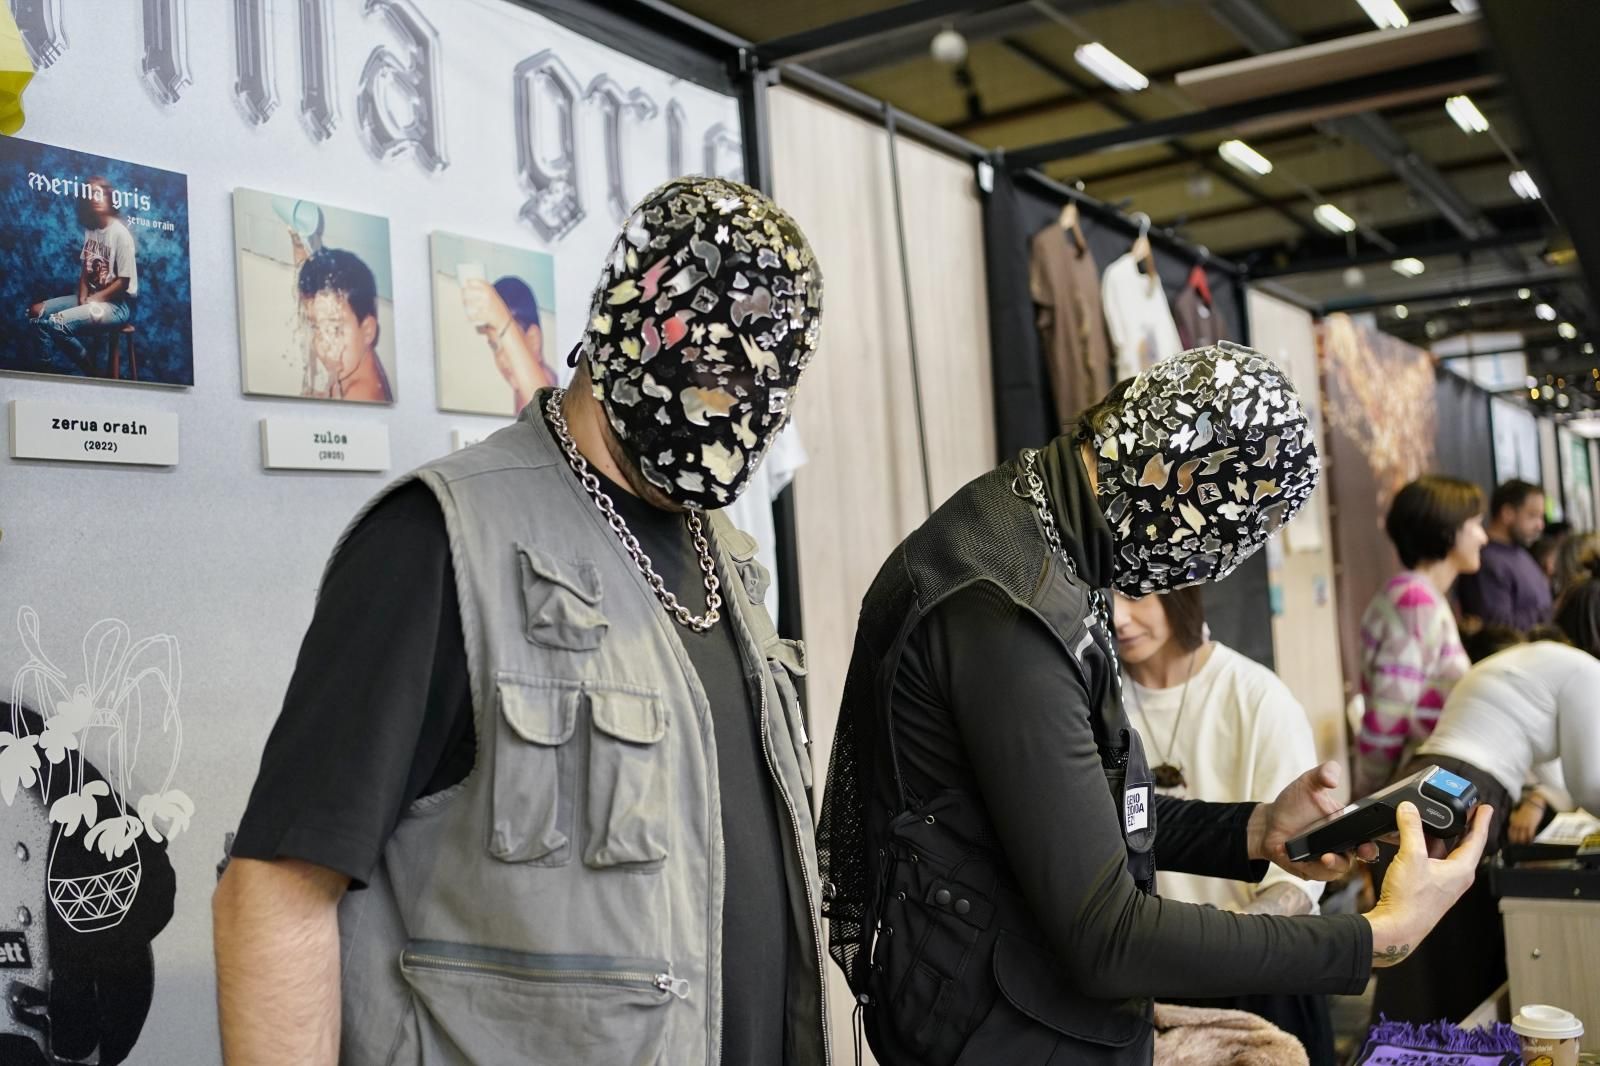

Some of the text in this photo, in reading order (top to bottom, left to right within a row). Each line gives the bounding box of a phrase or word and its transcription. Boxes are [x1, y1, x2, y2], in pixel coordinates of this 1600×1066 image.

[28, 172, 151, 212] Merina gris
[52, 418, 148, 435] zerua orain
[313, 431, 348, 444] zuloa
[84, 441, 118, 452] (2022)
